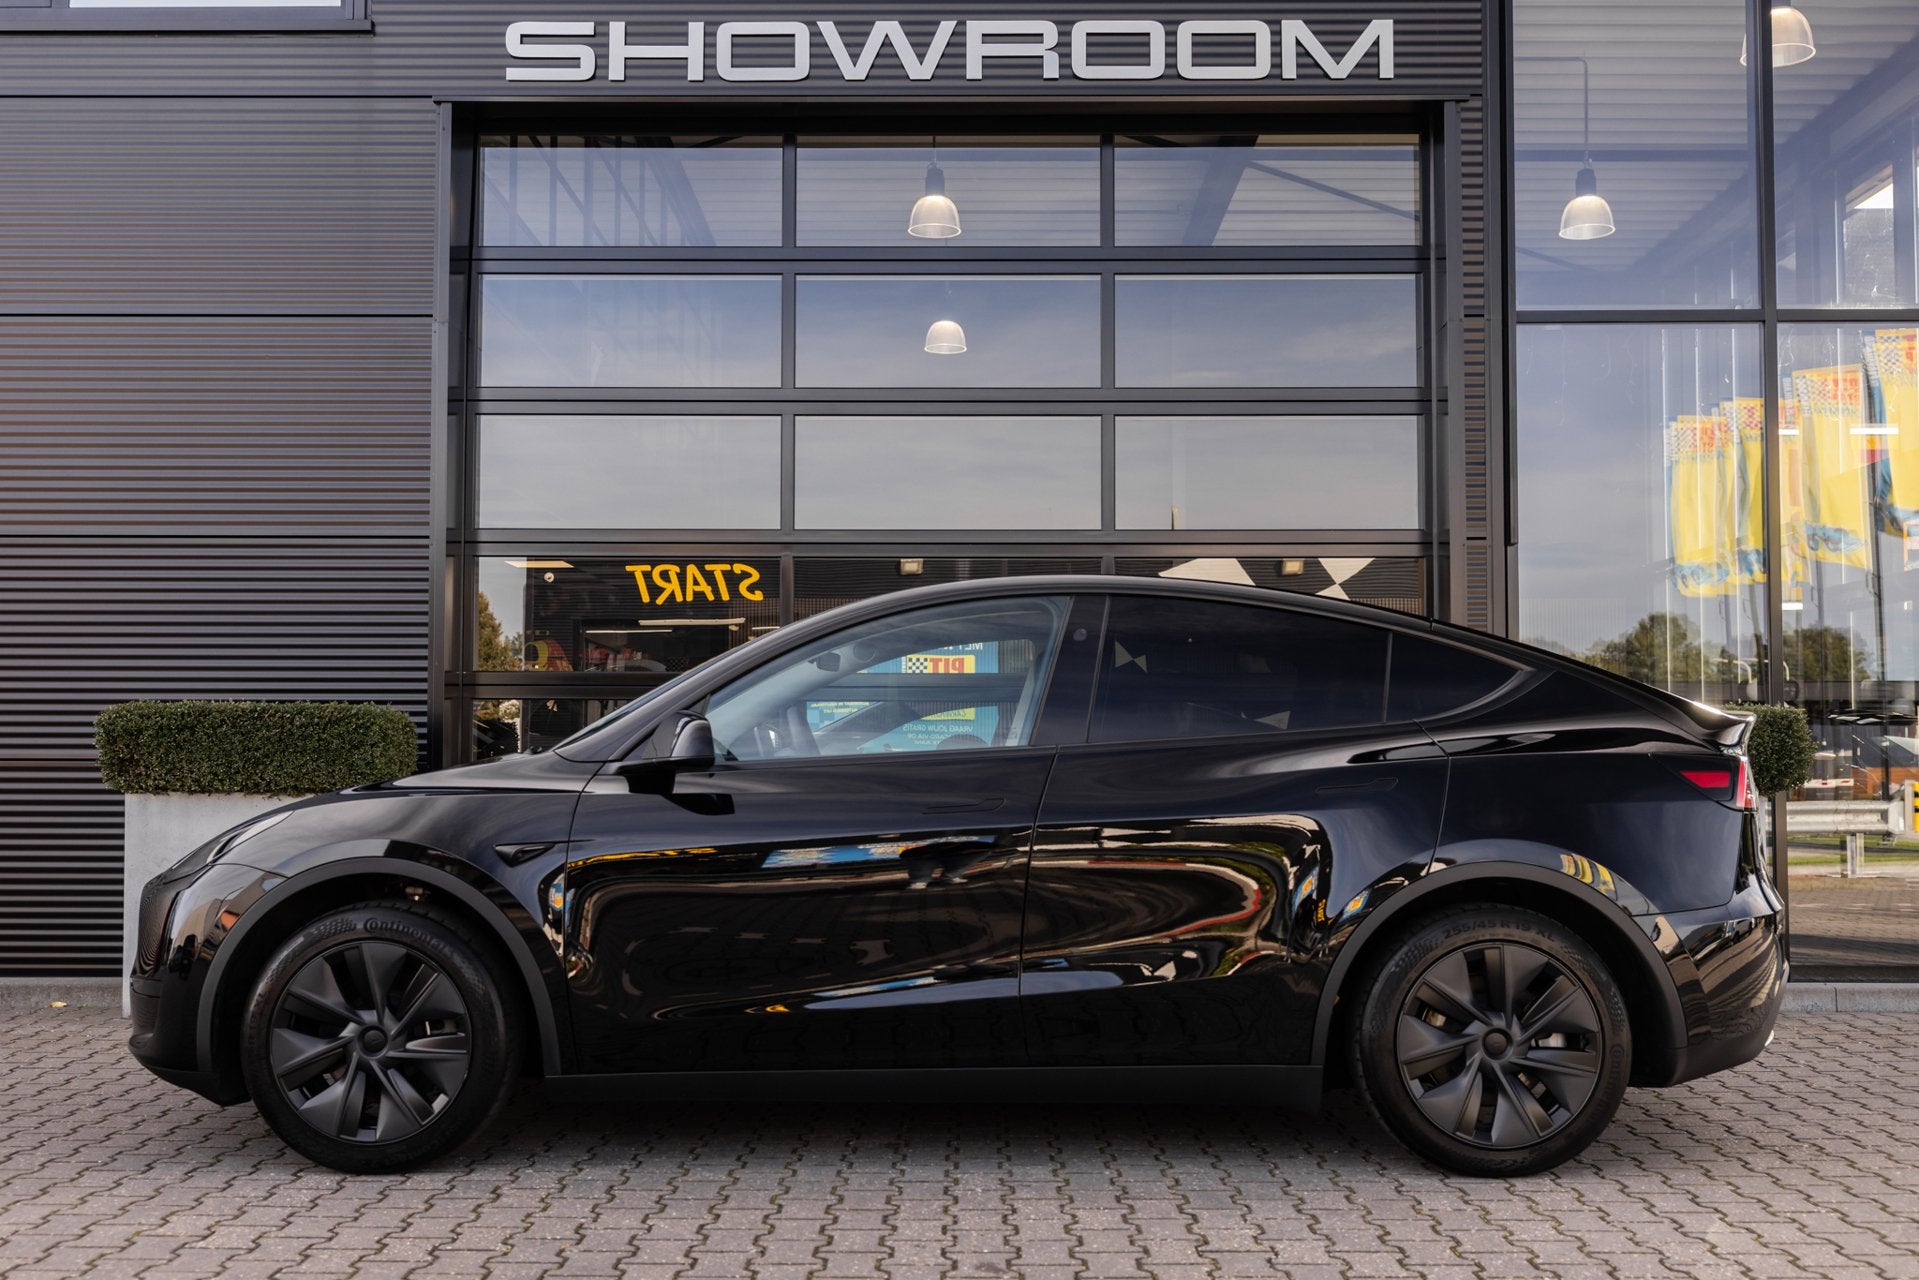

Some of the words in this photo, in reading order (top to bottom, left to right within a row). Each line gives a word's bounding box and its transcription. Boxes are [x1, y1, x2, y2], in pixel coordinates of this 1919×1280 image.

[504, 20, 1395, 81] SHOWROOM
[363, 917, 448, 955] Continental
[1443, 920, 1497, 939] 255/45
